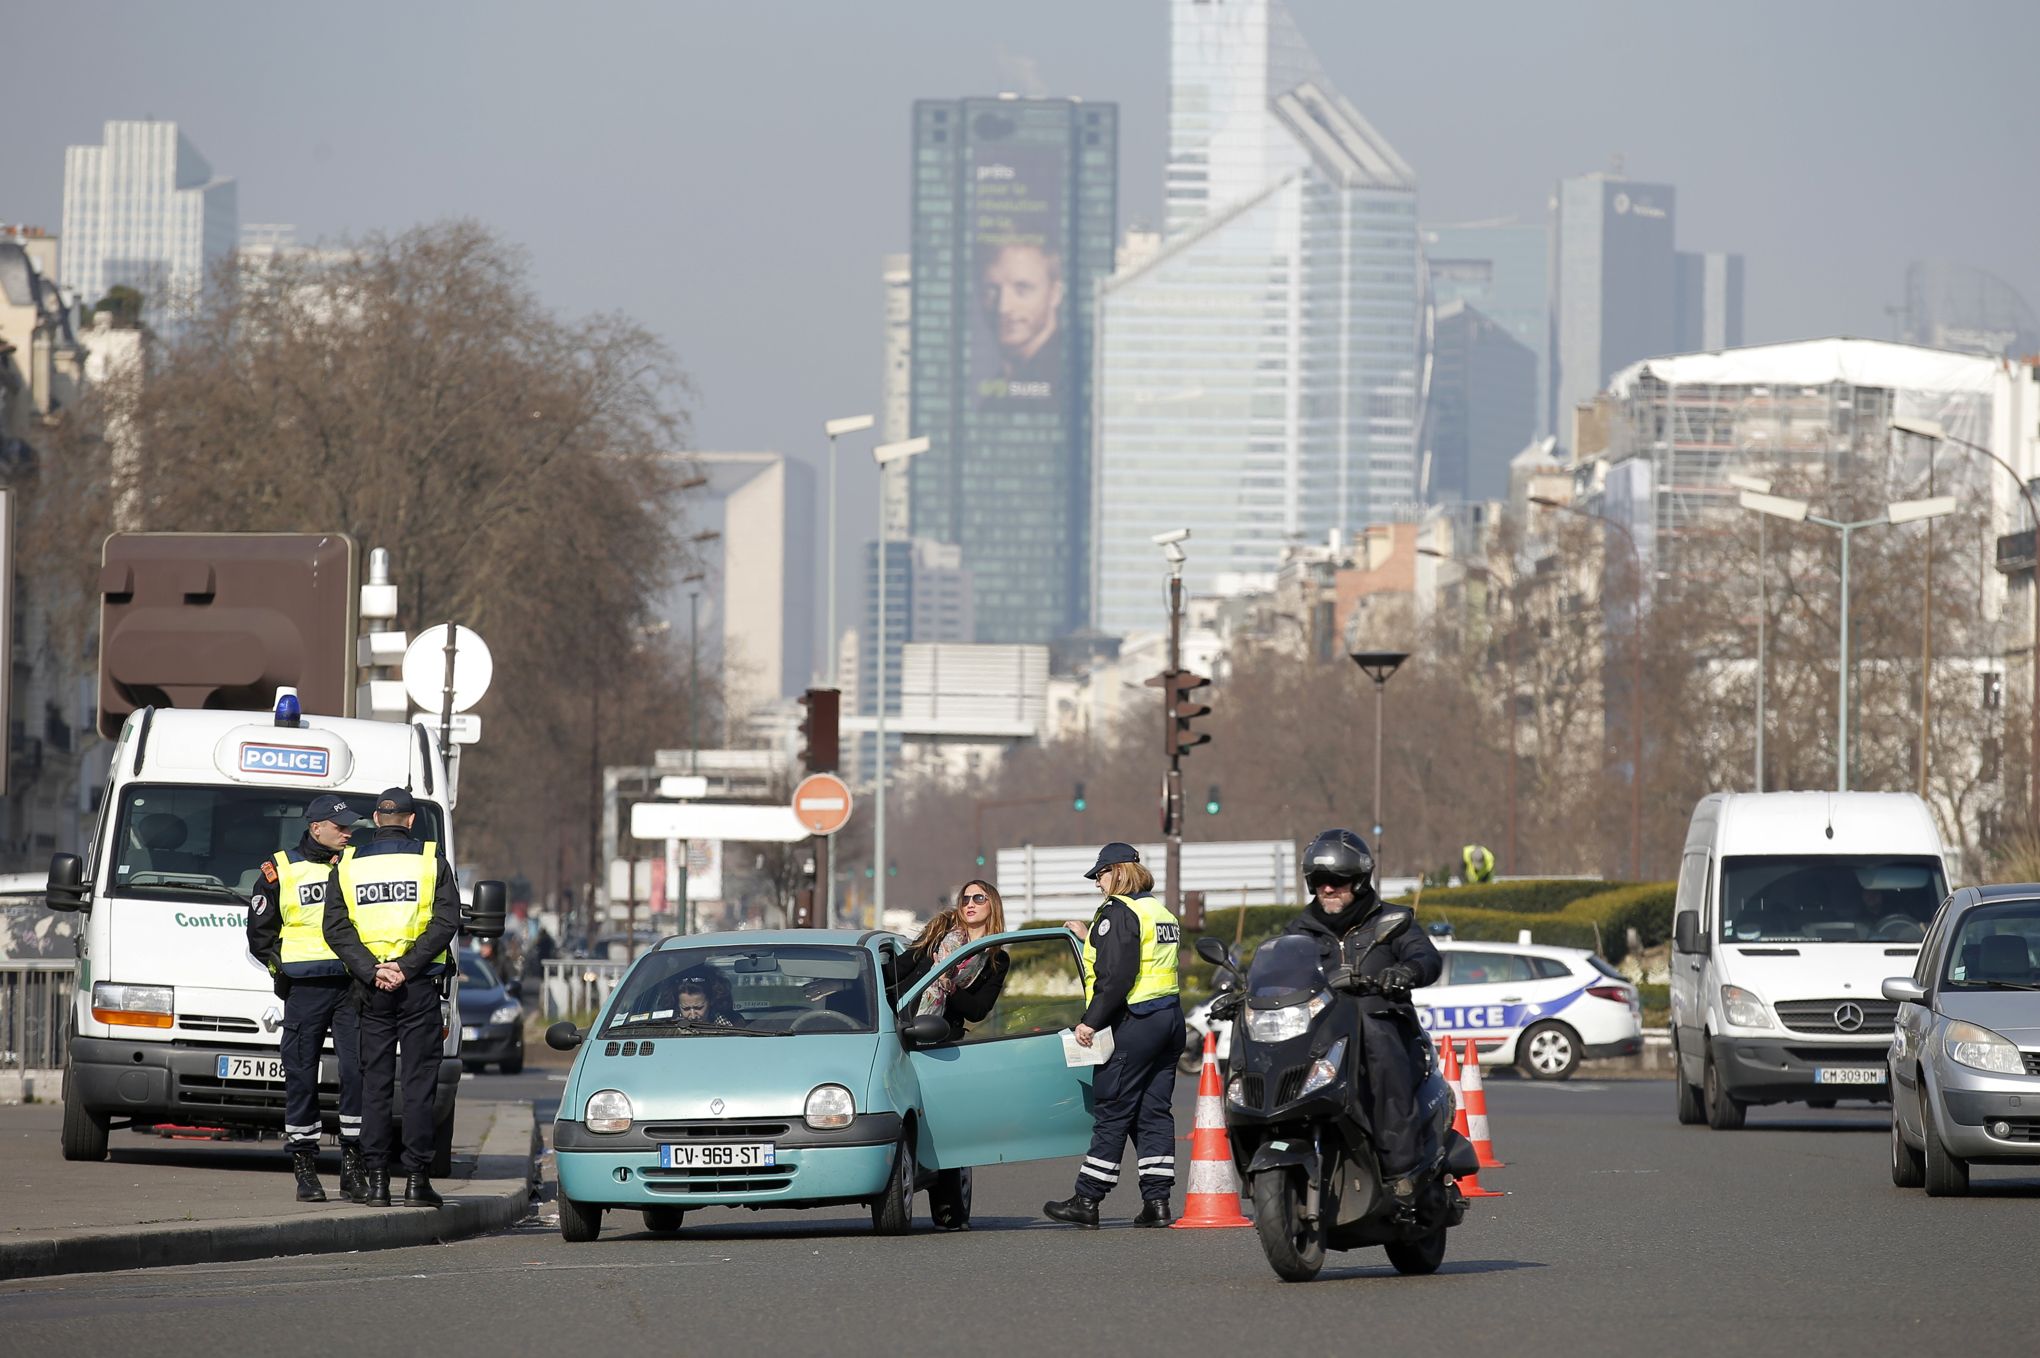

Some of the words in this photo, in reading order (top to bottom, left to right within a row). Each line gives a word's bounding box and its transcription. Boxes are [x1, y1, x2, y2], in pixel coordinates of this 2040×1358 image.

[246, 750, 323, 770] POLICE
[357, 883, 416, 902] POLICE
[1415, 1007, 1504, 1030] OLICE
[233, 1060, 251, 1076] 75
[256, 1061, 265, 1076] N
[765, 1155, 774, 1164] 49
